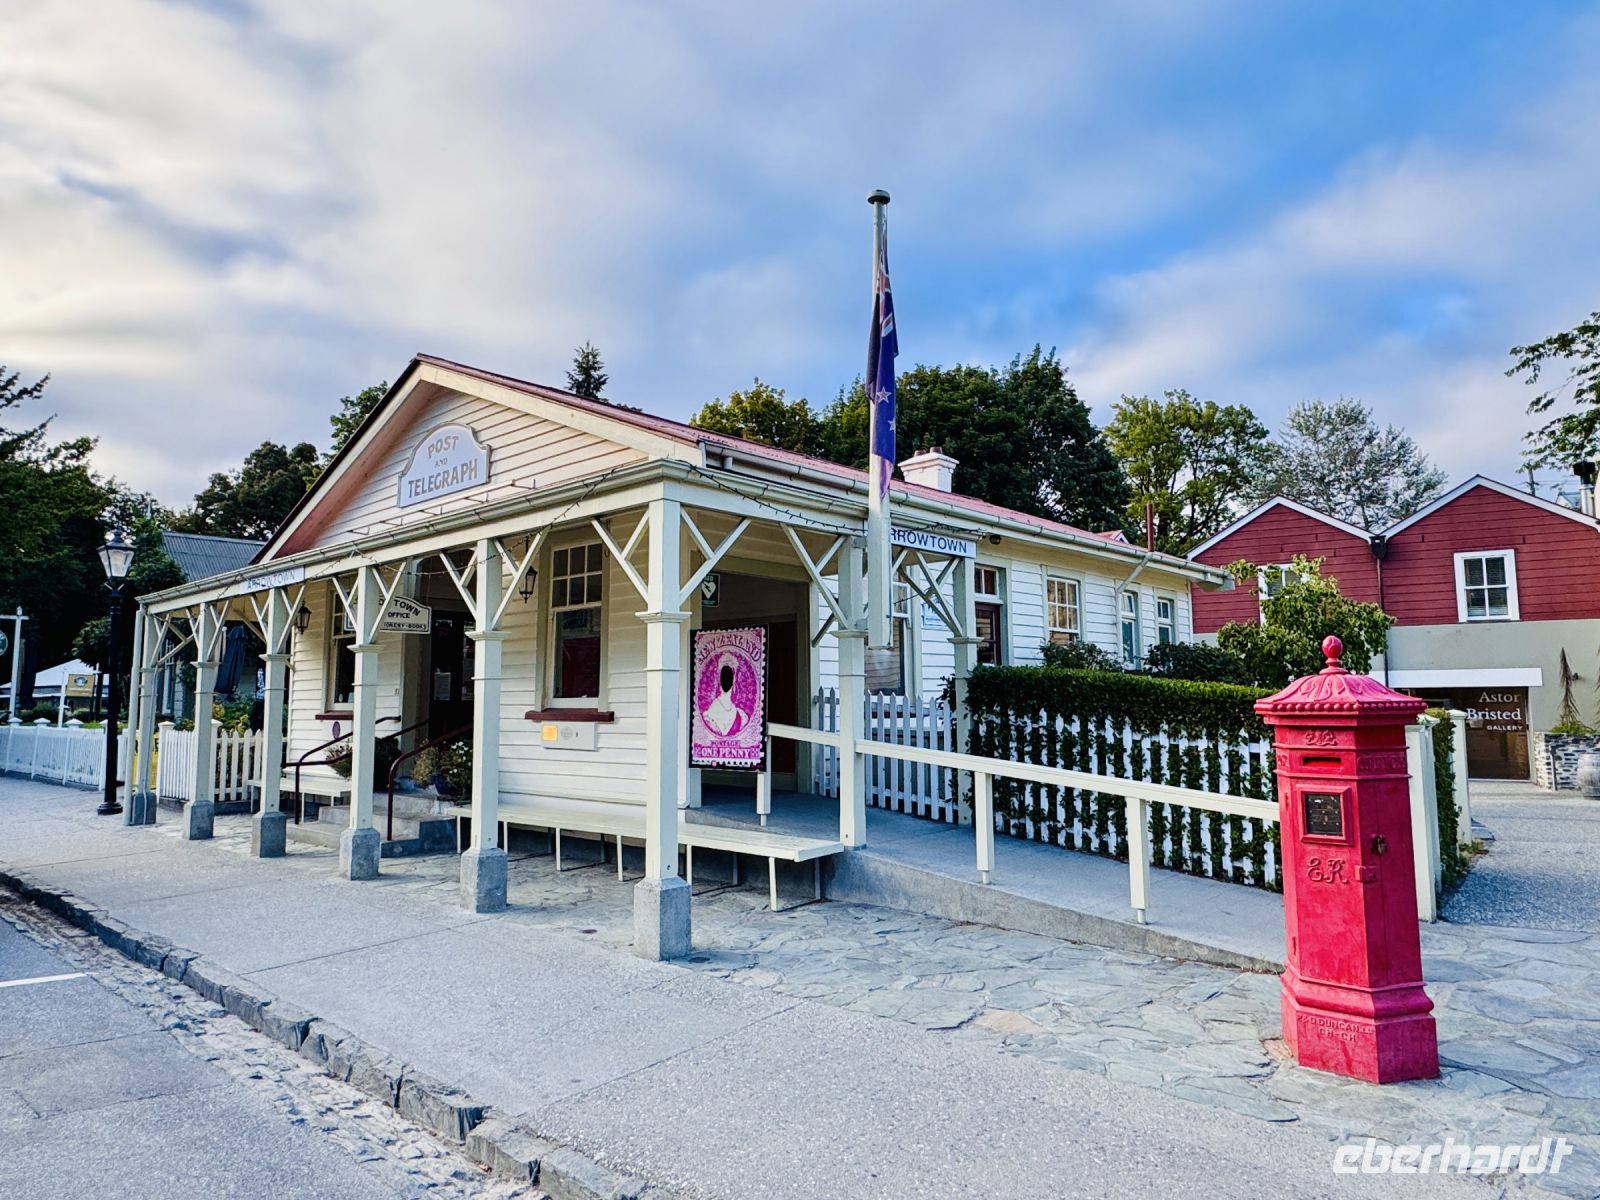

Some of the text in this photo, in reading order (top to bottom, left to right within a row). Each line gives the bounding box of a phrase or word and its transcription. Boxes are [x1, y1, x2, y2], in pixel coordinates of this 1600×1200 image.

[427, 435, 459, 459] POST
[434, 458, 448, 468] AND
[408, 459, 478, 498] TELEGRAPH
[890, 527, 967, 554] RROWTOWN
[387, 611, 411, 619] OFFICE
[1478, 691, 1520, 703] Astor
[1466, 708, 1521, 720] Bristed
[701, 747, 750, 758] ONE PENNY
